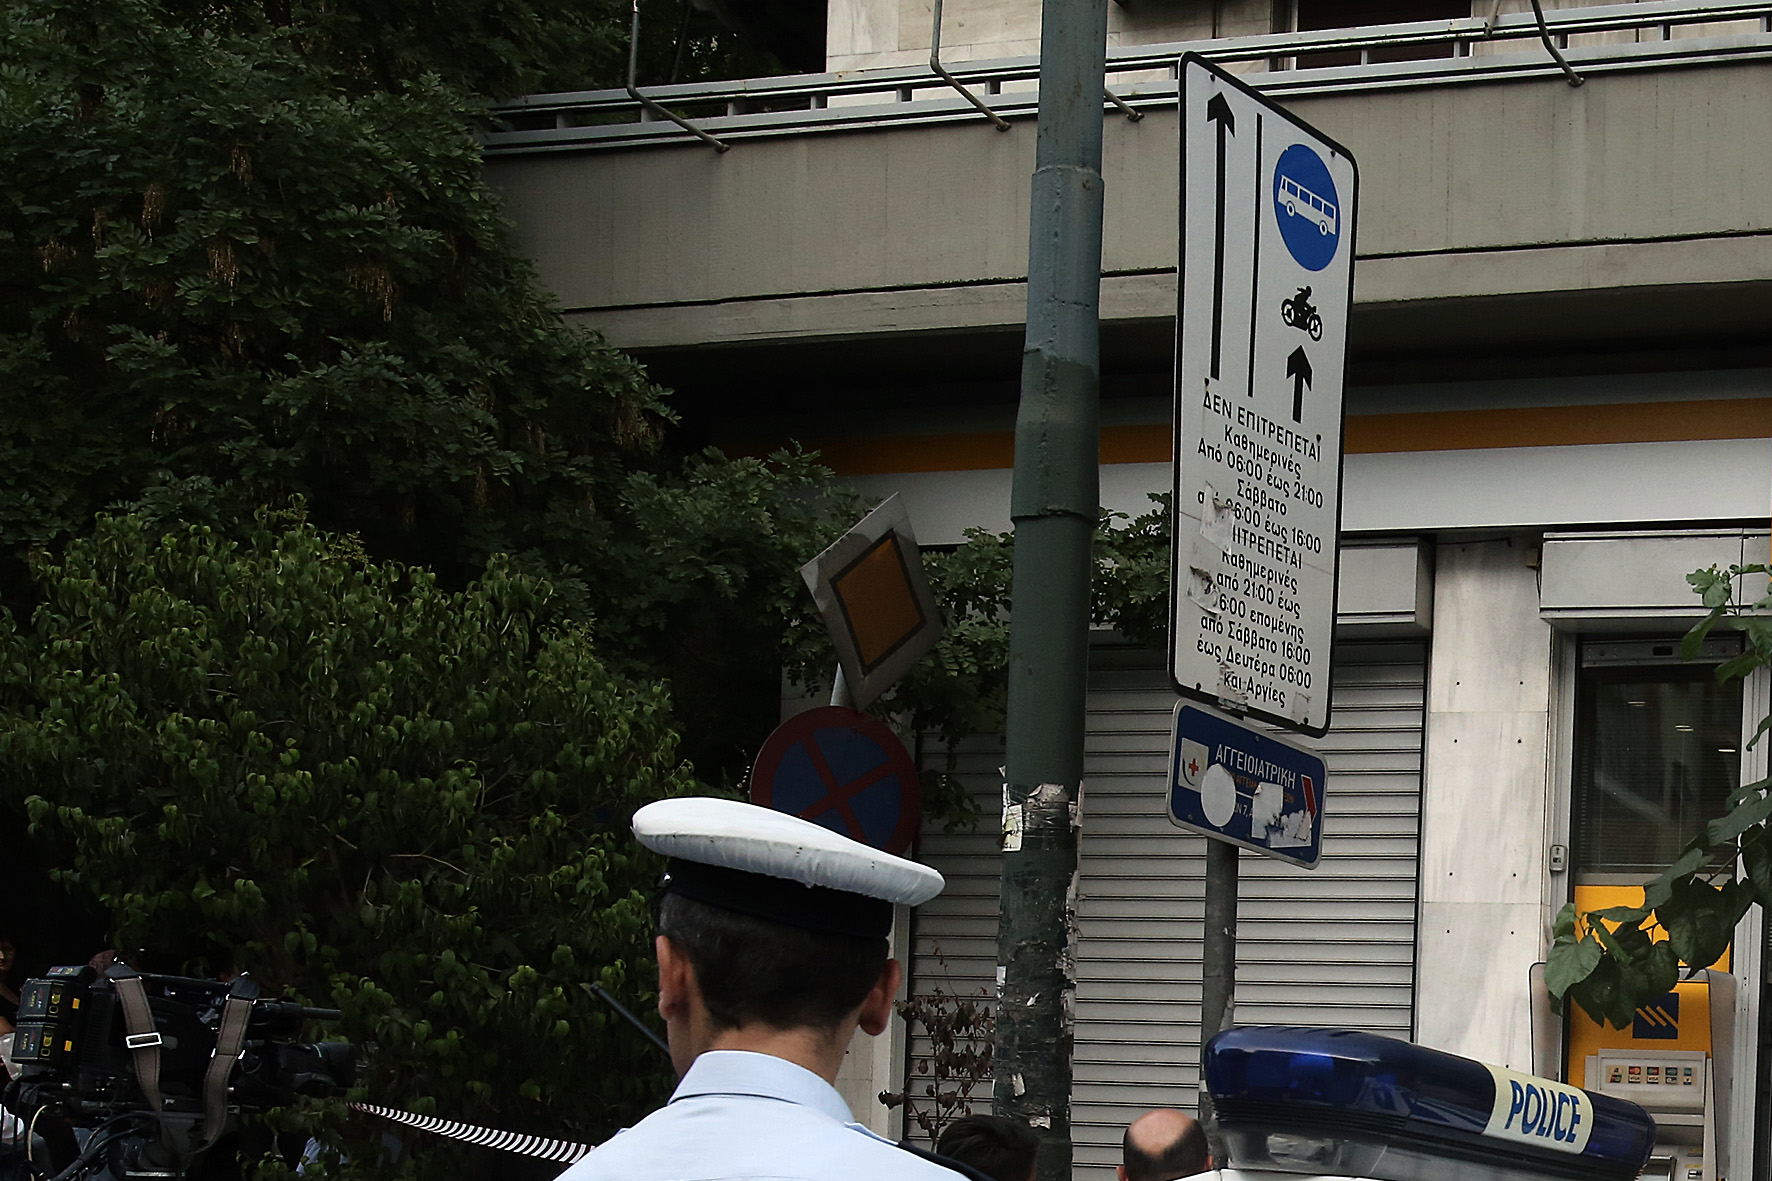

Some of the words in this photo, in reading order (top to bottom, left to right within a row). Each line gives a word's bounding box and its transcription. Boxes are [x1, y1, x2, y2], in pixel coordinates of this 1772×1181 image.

[1203, 391, 1232, 419] ΔΕΝ
[1237, 406, 1320, 462] ΕΠΙΤΡΕΠΕΤΑΙ
[1197, 437, 1222, 463] Από
[1227, 451, 1262, 481] 06:00
[1266, 468, 1290, 498] έως
[1294, 481, 1323, 508] 21:00
[1224, 424, 1301, 480] Καθημερινές
[1237, 479, 1287, 515] Σάββατο
[1264, 514, 1288, 544] έως
[1292, 527, 1321, 554] 16:00
[1216, 572, 1239, 591] από
[1243, 578, 1274, 605] 21:00
[1277, 590, 1301, 619] έως
[1218, 593, 1246, 618] 6:00
[1250, 609, 1304, 644] επομένης
[1196, 633, 1222, 663] έως
[1226, 645, 1275, 678] Δευτέρα
[1279, 663, 1311, 689] 06:00
[1200, 615, 1224, 635] από
[1227, 620, 1278, 654] Σάββατο
[1281, 640, 1311, 665] 16:00
[1246, 676, 1286, 708] Αργίες
[1215, 744, 1296, 790] ΑΓΓΕΙΟΙΑΤΡΙΚΗ
[1504, 1079, 1581, 1144] POLICE
